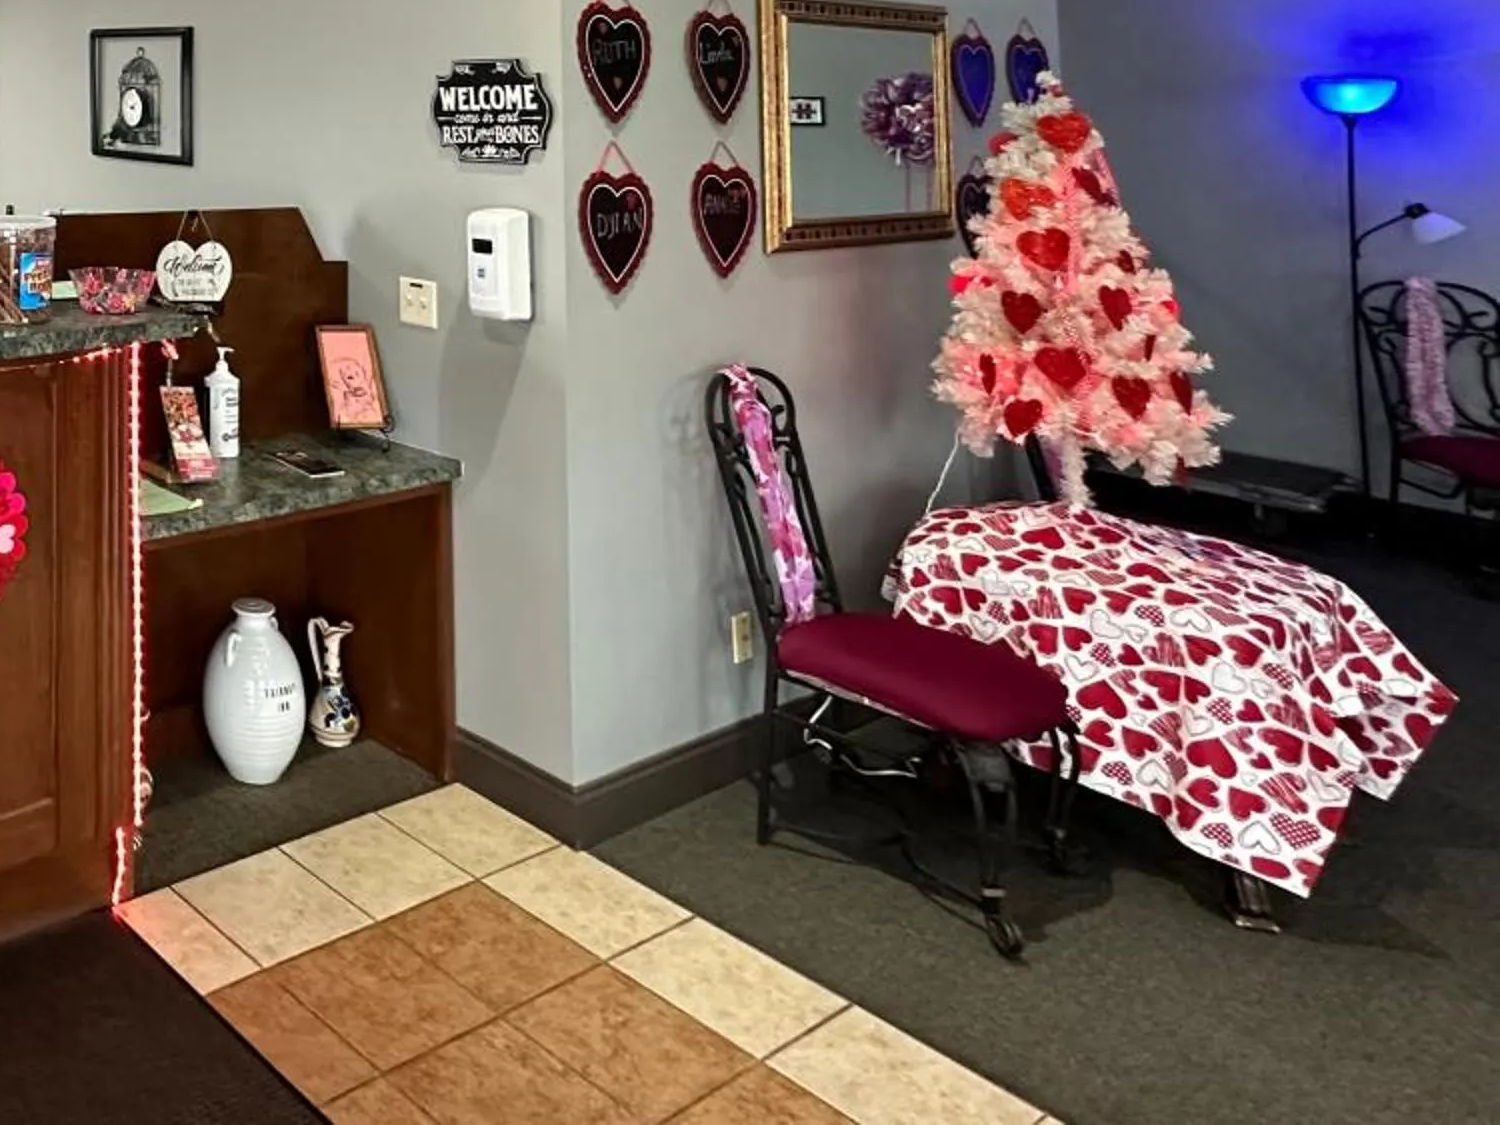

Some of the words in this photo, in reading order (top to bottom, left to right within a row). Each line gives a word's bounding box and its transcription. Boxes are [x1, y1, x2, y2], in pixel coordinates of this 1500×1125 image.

[439, 83, 539, 112] WELCOME
[443, 125, 474, 144] REST
[495, 124, 540, 144] BONES
